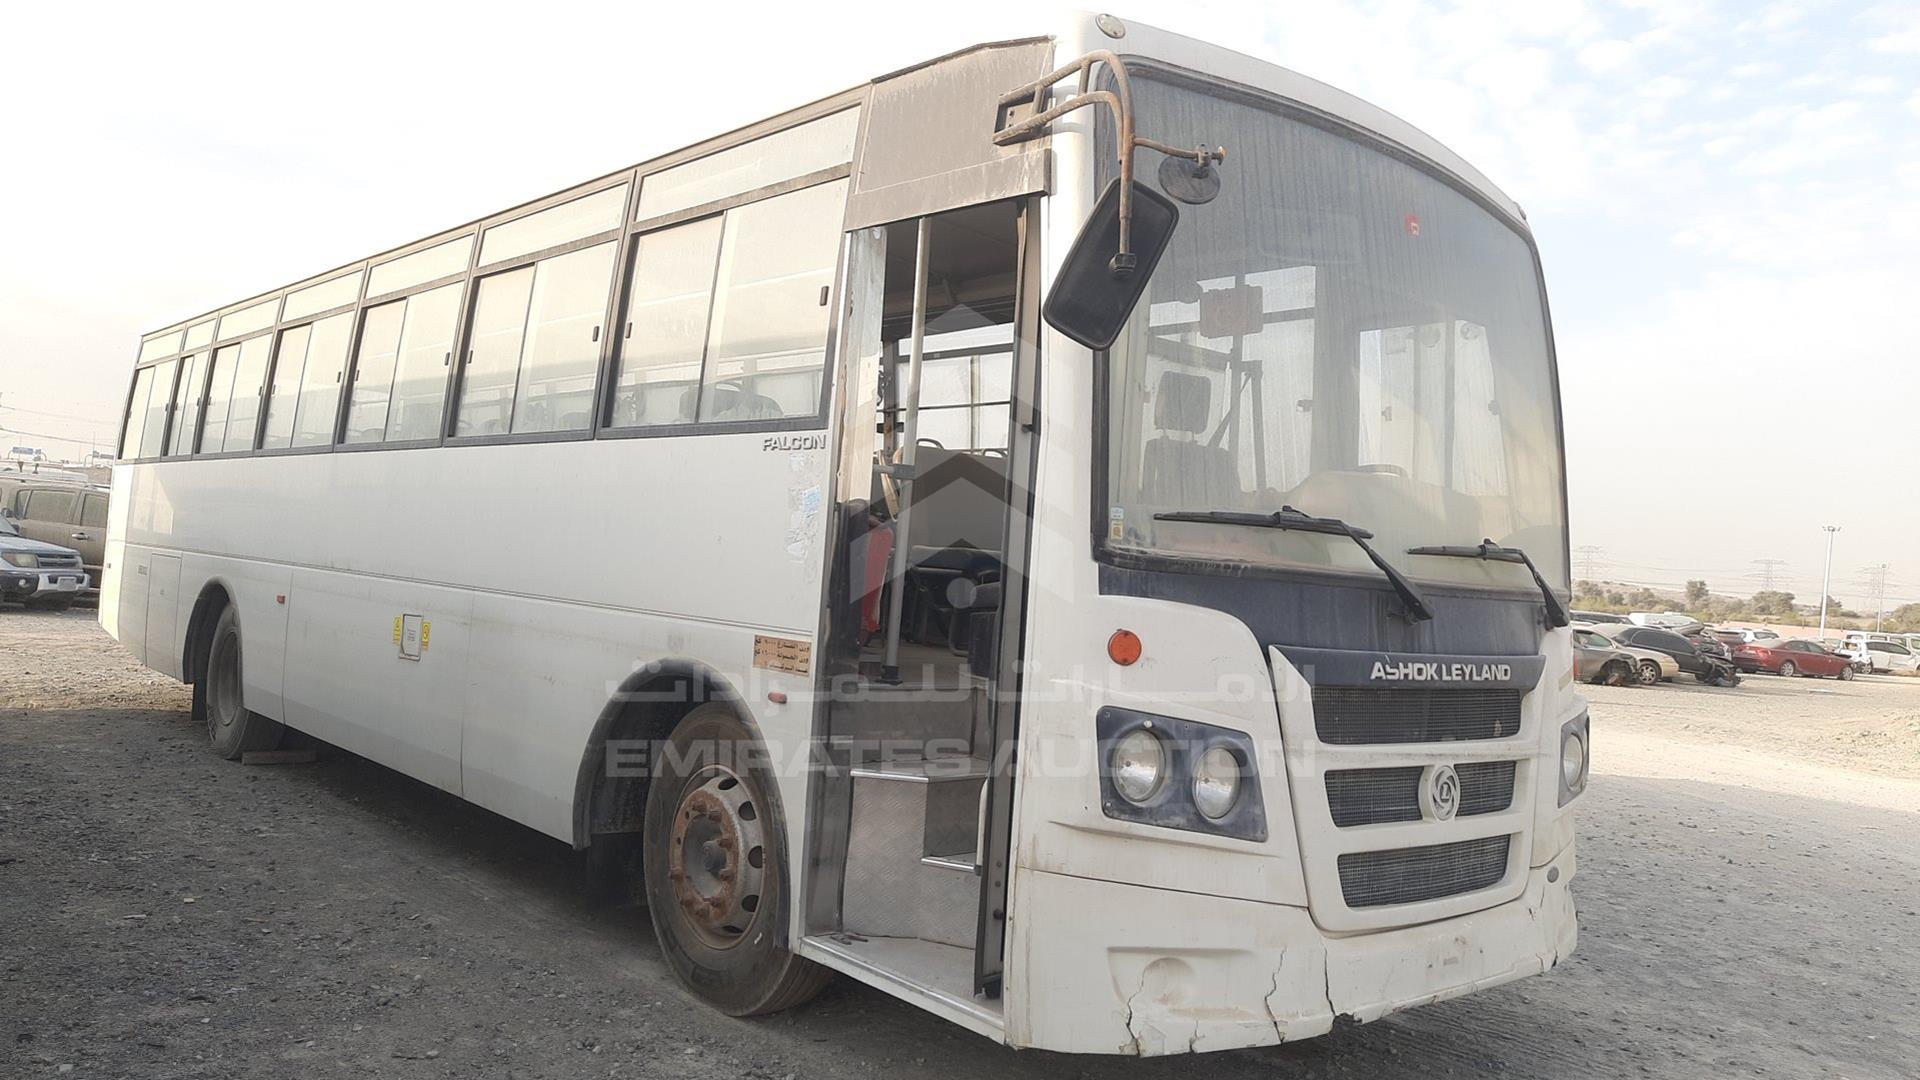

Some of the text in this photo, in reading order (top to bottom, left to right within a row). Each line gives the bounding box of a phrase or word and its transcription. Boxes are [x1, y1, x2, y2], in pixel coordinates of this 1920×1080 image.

[763, 434, 827, 451] FALCON
[1370, 661, 1512, 681] ASHOK LEYLAND
